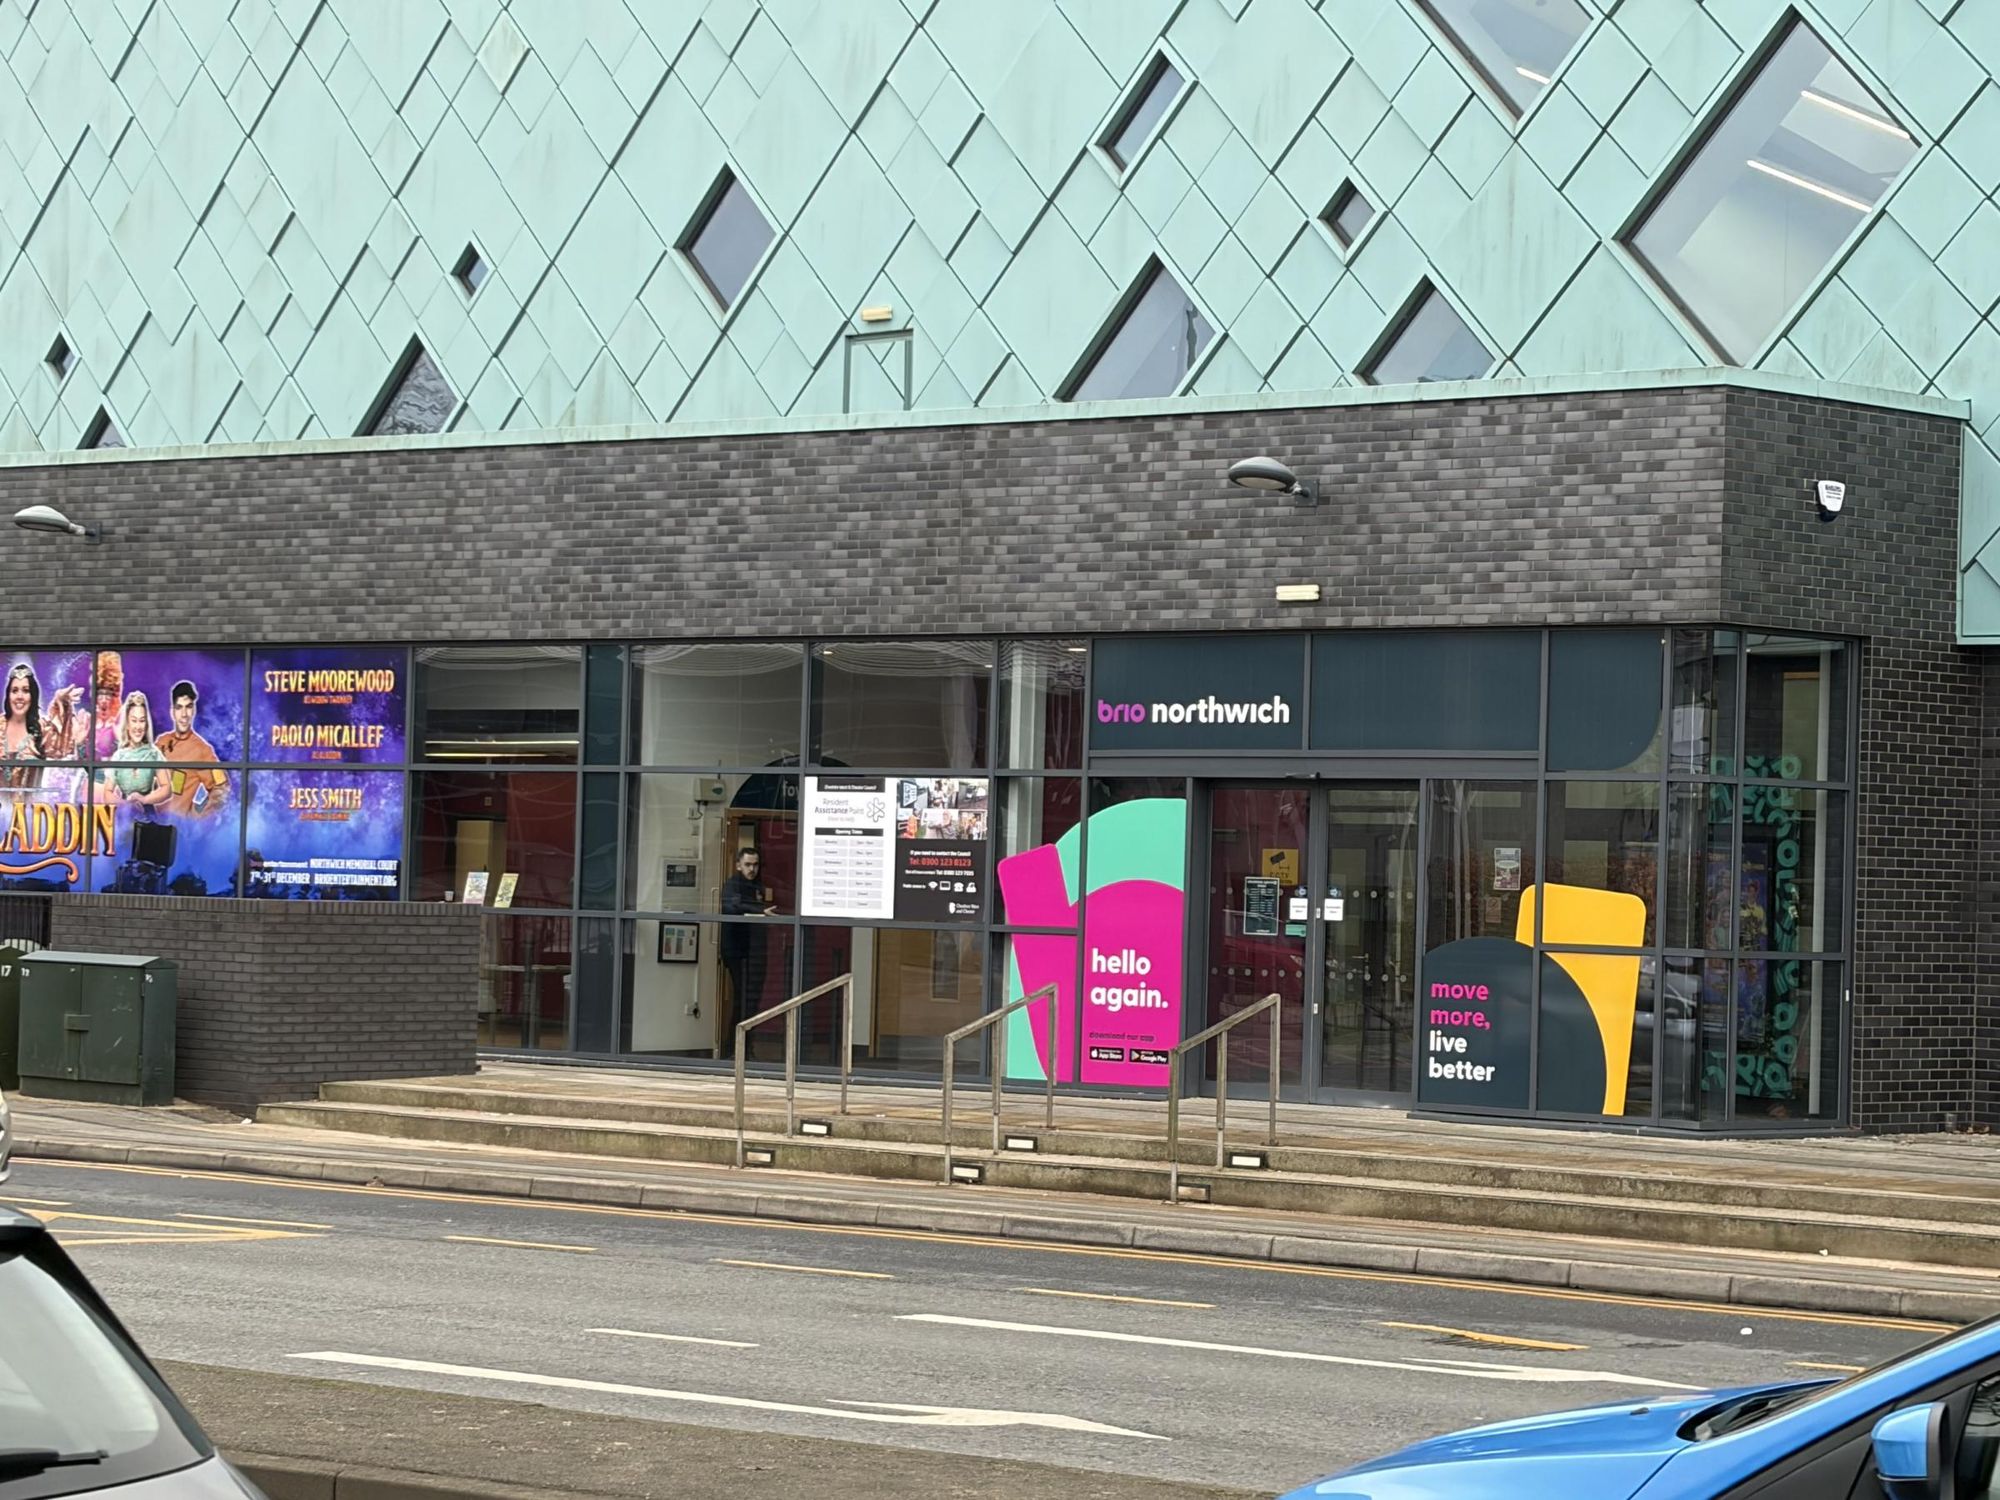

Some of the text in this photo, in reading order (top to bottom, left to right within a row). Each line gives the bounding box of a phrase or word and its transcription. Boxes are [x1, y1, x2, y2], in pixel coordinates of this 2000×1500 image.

[264, 669, 395, 693] STEVE MOOREWOOD
[1097, 695, 1290, 724] brio northwich
[271, 725, 385, 748] PAOLO MICALLEF
[289, 788, 363, 810] JESS SMITH
[815, 806, 848, 814] Assistance
[822, 798, 849, 806] Resident
[0, 801, 118, 856] ADDIN
[346, 859, 377, 870] MEMORIAL
[377, 860, 398, 871] COURT
[921, 857, 939, 866] 0300
[940, 858, 953, 866] 123
[276, 873, 310, 885] DECEMBER
[1091, 947, 1151, 975] hello
[1090, 981, 1169, 1012] again.
[1430, 982, 1489, 1001] move
[1429, 1009, 1491, 1030] more,
[1429, 1029, 1468, 1053] live
[1428, 1056, 1496, 1082] better
